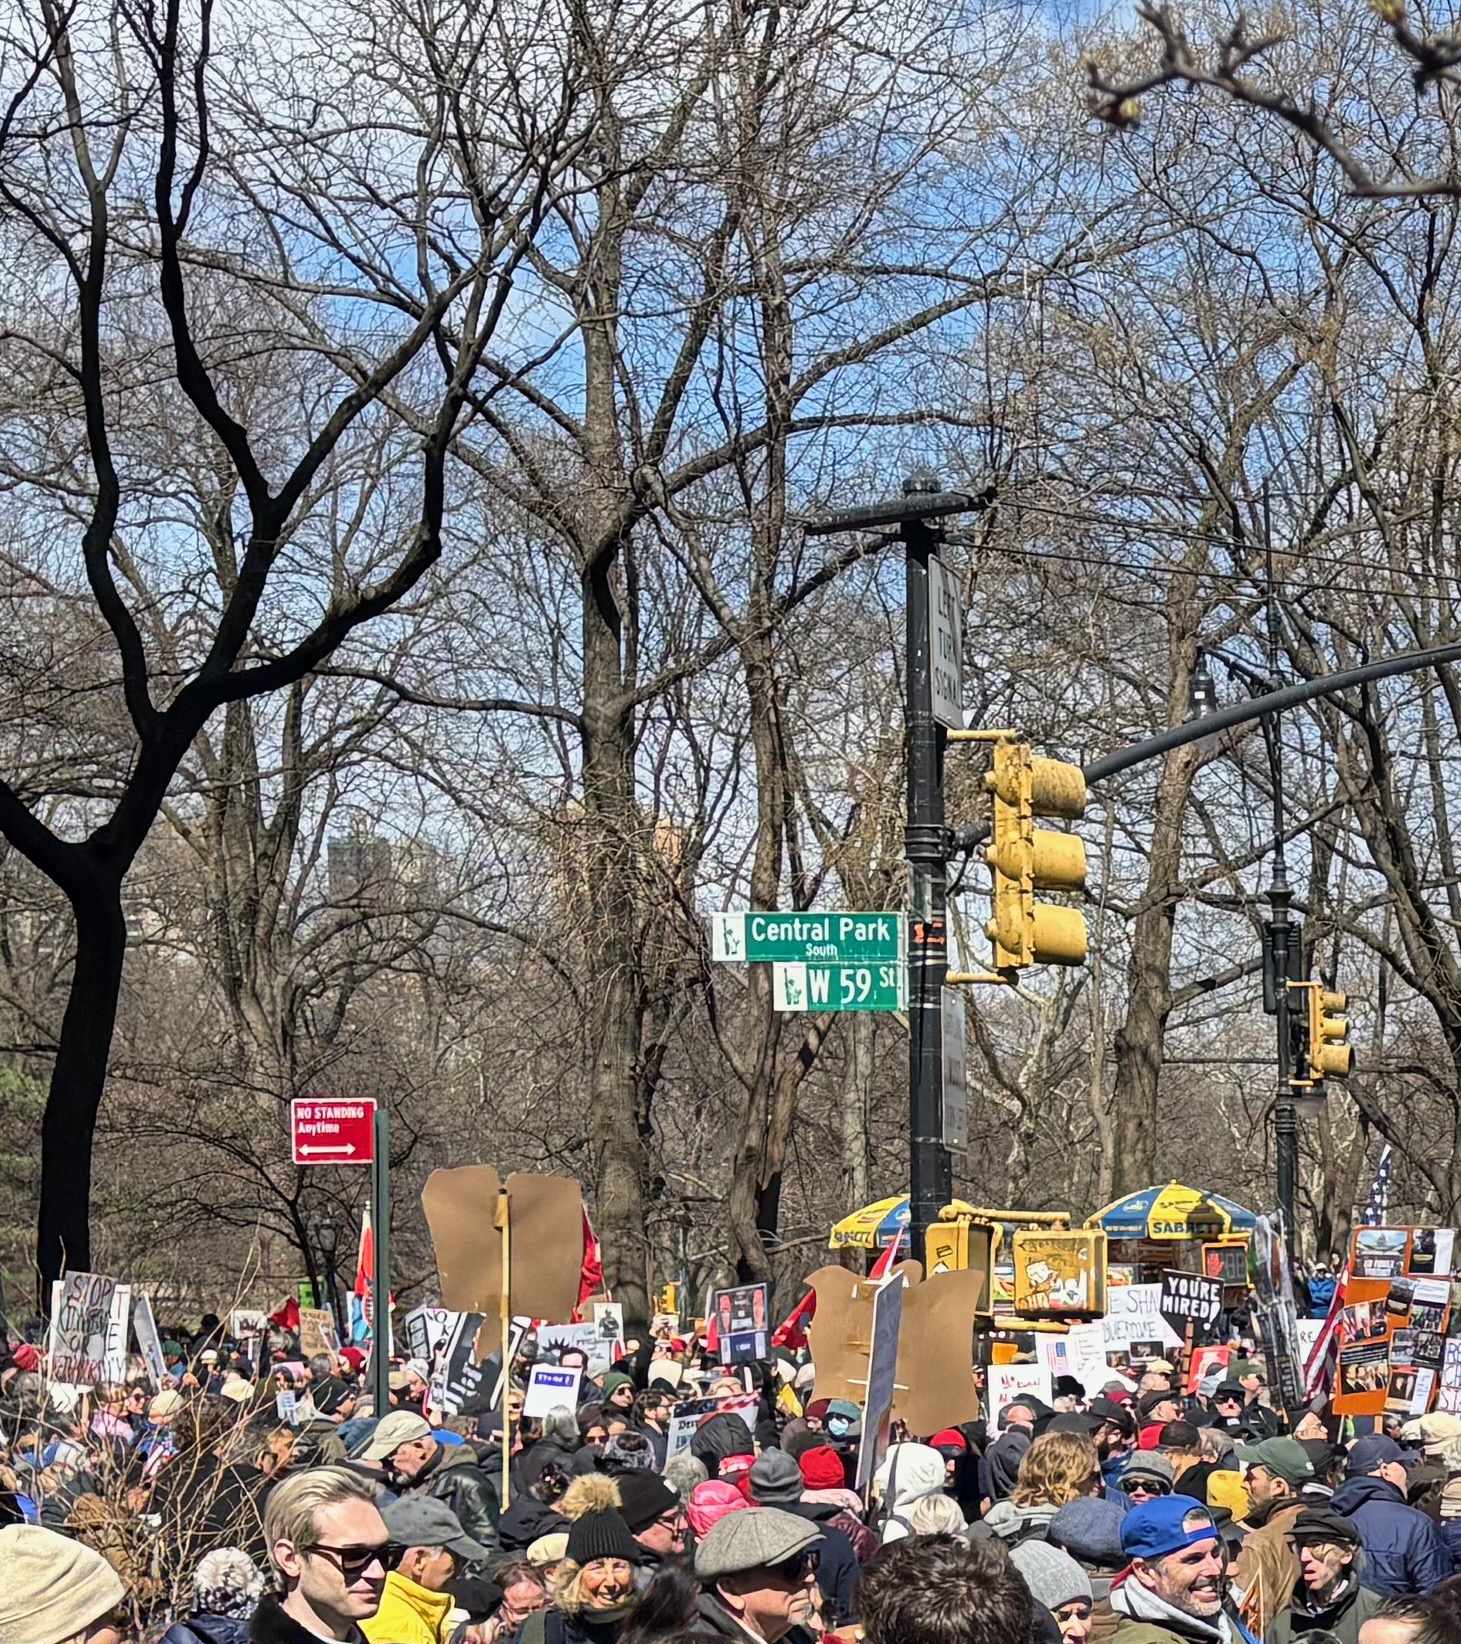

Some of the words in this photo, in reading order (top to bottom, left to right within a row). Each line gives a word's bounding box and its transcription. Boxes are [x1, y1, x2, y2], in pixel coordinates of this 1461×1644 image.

[752, 917, 830, 942] Central
[839, 917, 891, 942] Park
[805, 943, 838, 957] South
[809, 968, 831, 1004] W
[840, 968, 872, 1004] 59
[879, 966, 896, 988] St
[296, 1107, 312, 1119] NO
[314, 1106, 365, 1119] STANDING
[298, 1121, 340, 1136] Anytime
